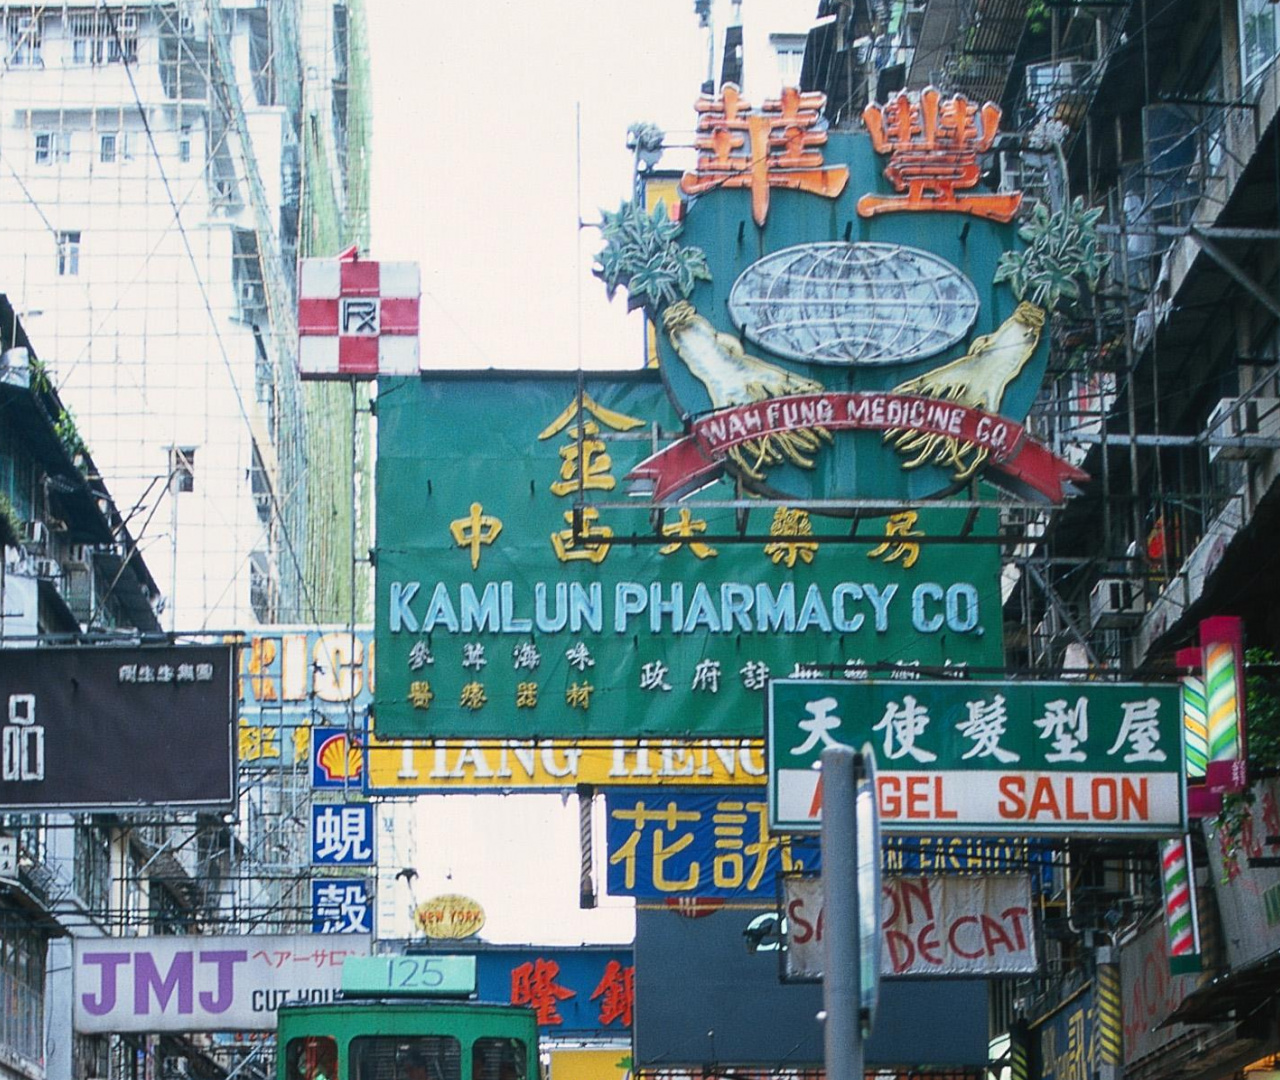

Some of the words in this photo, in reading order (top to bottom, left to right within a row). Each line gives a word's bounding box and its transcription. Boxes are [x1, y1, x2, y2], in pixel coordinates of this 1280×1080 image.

[701, 411, 762, 446] WAH
[767, 398, 833, 430] FUNG
[848, 397, 966, 434] MEDICINE
[389, 580, 602, 634] KAMLUN
[614, 581, 900, 635] PHARMACY
[911, 581, 985, 636] CO.
[790, 694, 1167, 765] 天使髮型屋
[999, 776, 1149, 821] SALON
[420, 910, 444, 925] NEW
[448, 910, 482, 925] YORK
[82, 950, 248, 1017] JMJ
[387, 959, 444, 988] 125
[253, 989, 292, 1012] CUT
